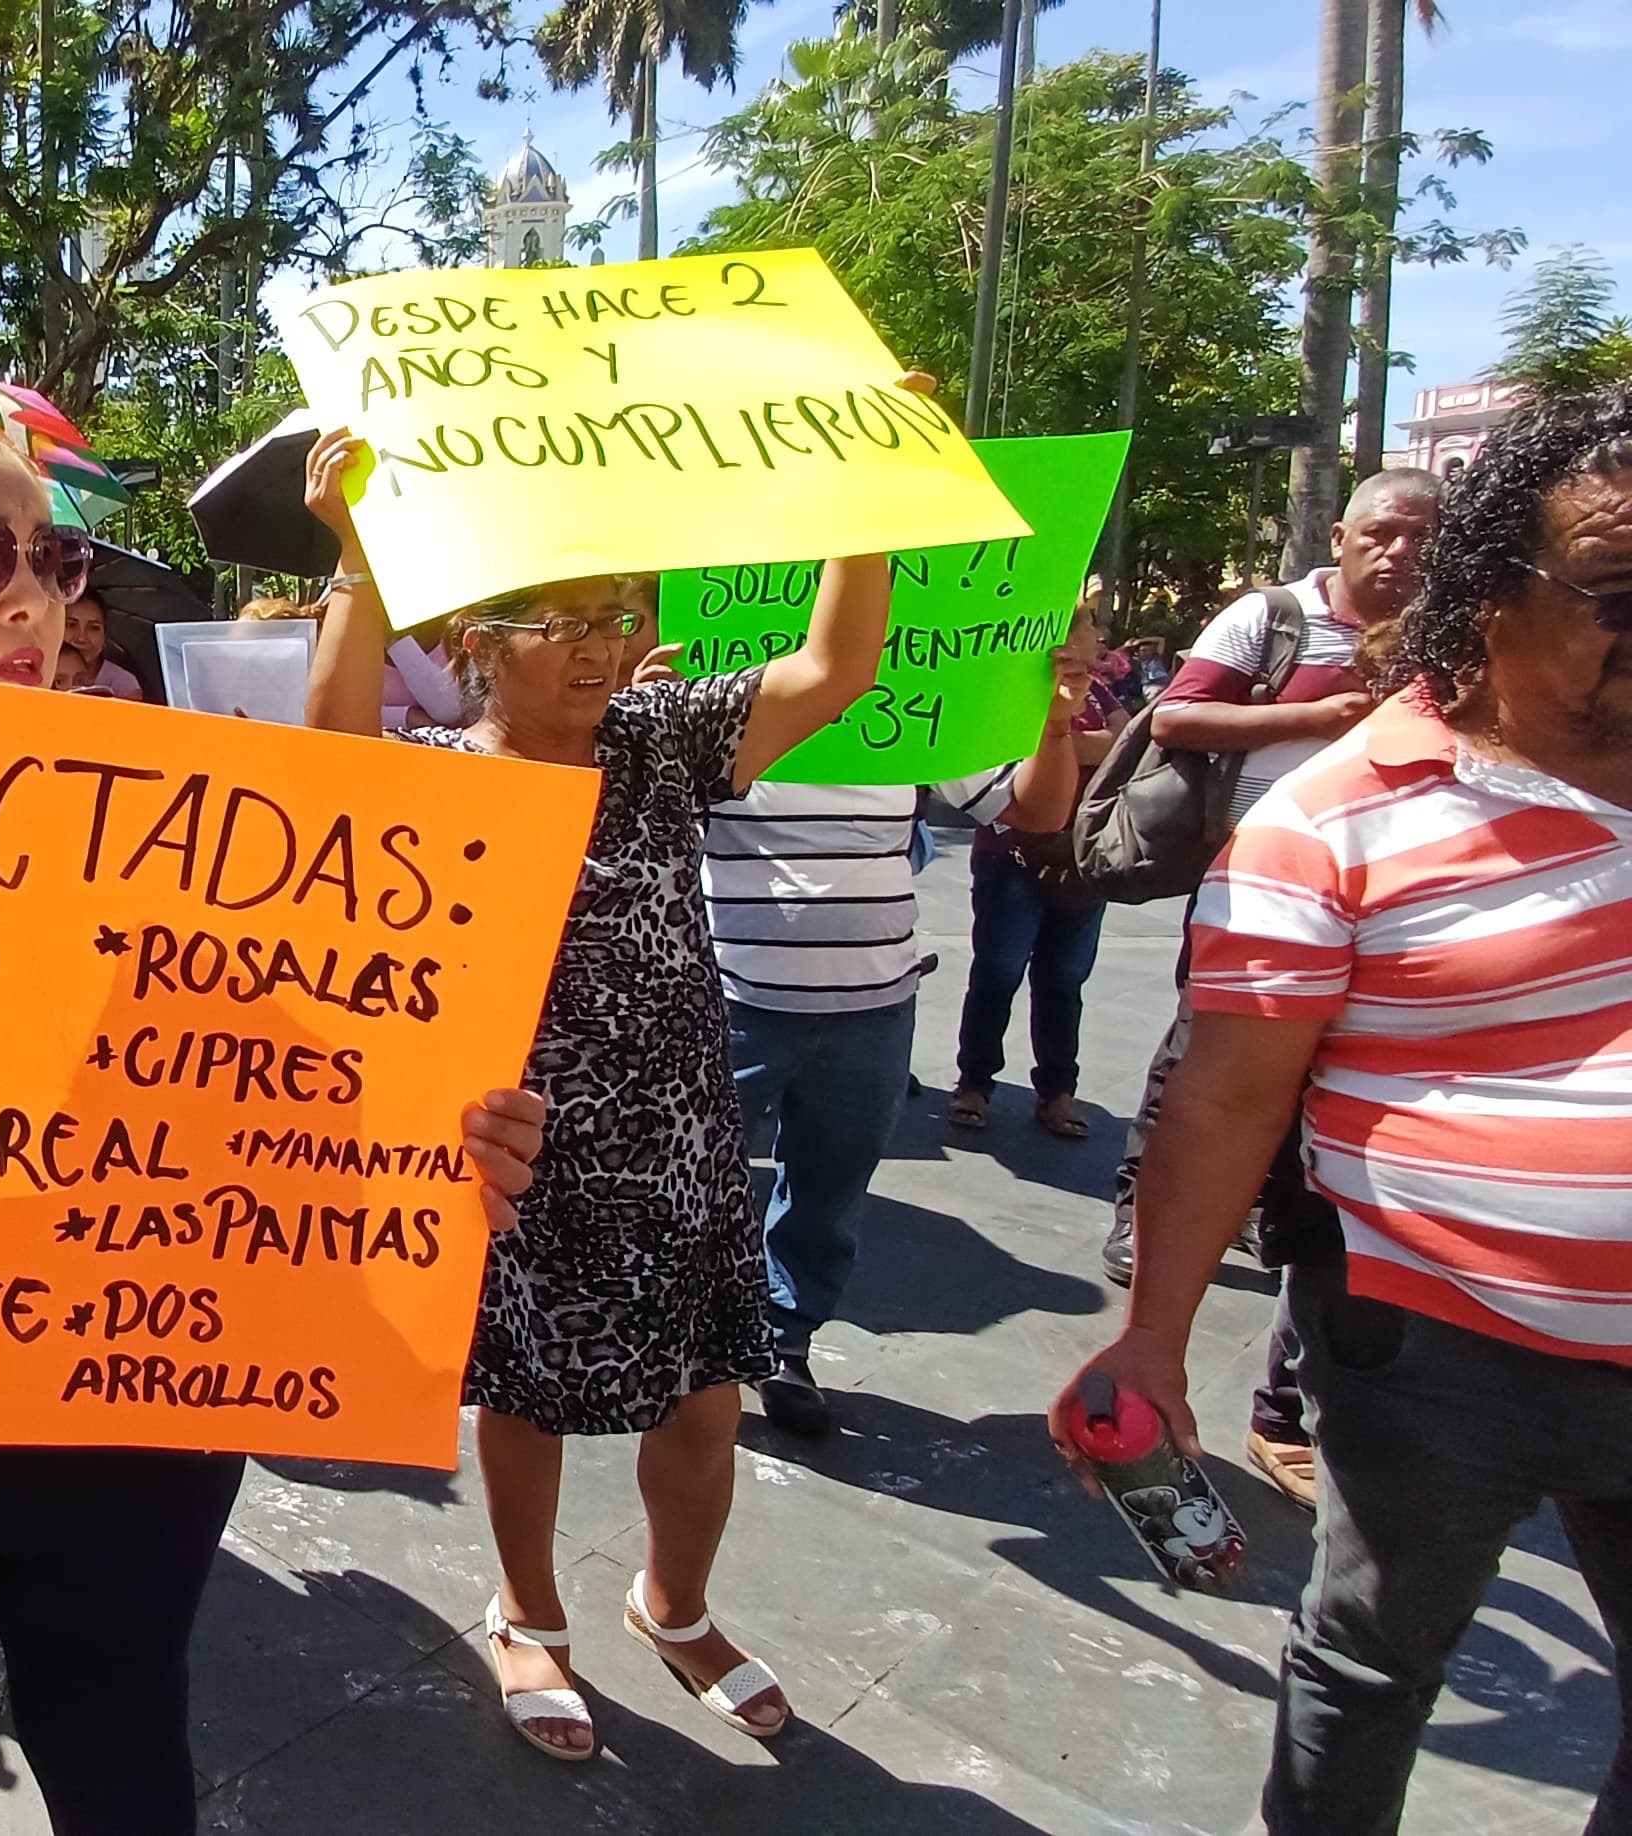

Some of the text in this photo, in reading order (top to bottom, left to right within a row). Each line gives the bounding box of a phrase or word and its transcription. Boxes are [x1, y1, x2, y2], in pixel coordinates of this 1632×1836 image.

[300, 262, 789, 351] DESDE HACE 2
[361, 342, 619, 412] AÑOS Y
[861, 684, 942, 749] 34
[246, 1128, 473, 1183] MANANTIAL
[102, 1280, 223, 1343] DOS
[61, 1353, 341, 1420] ARROLLOS
